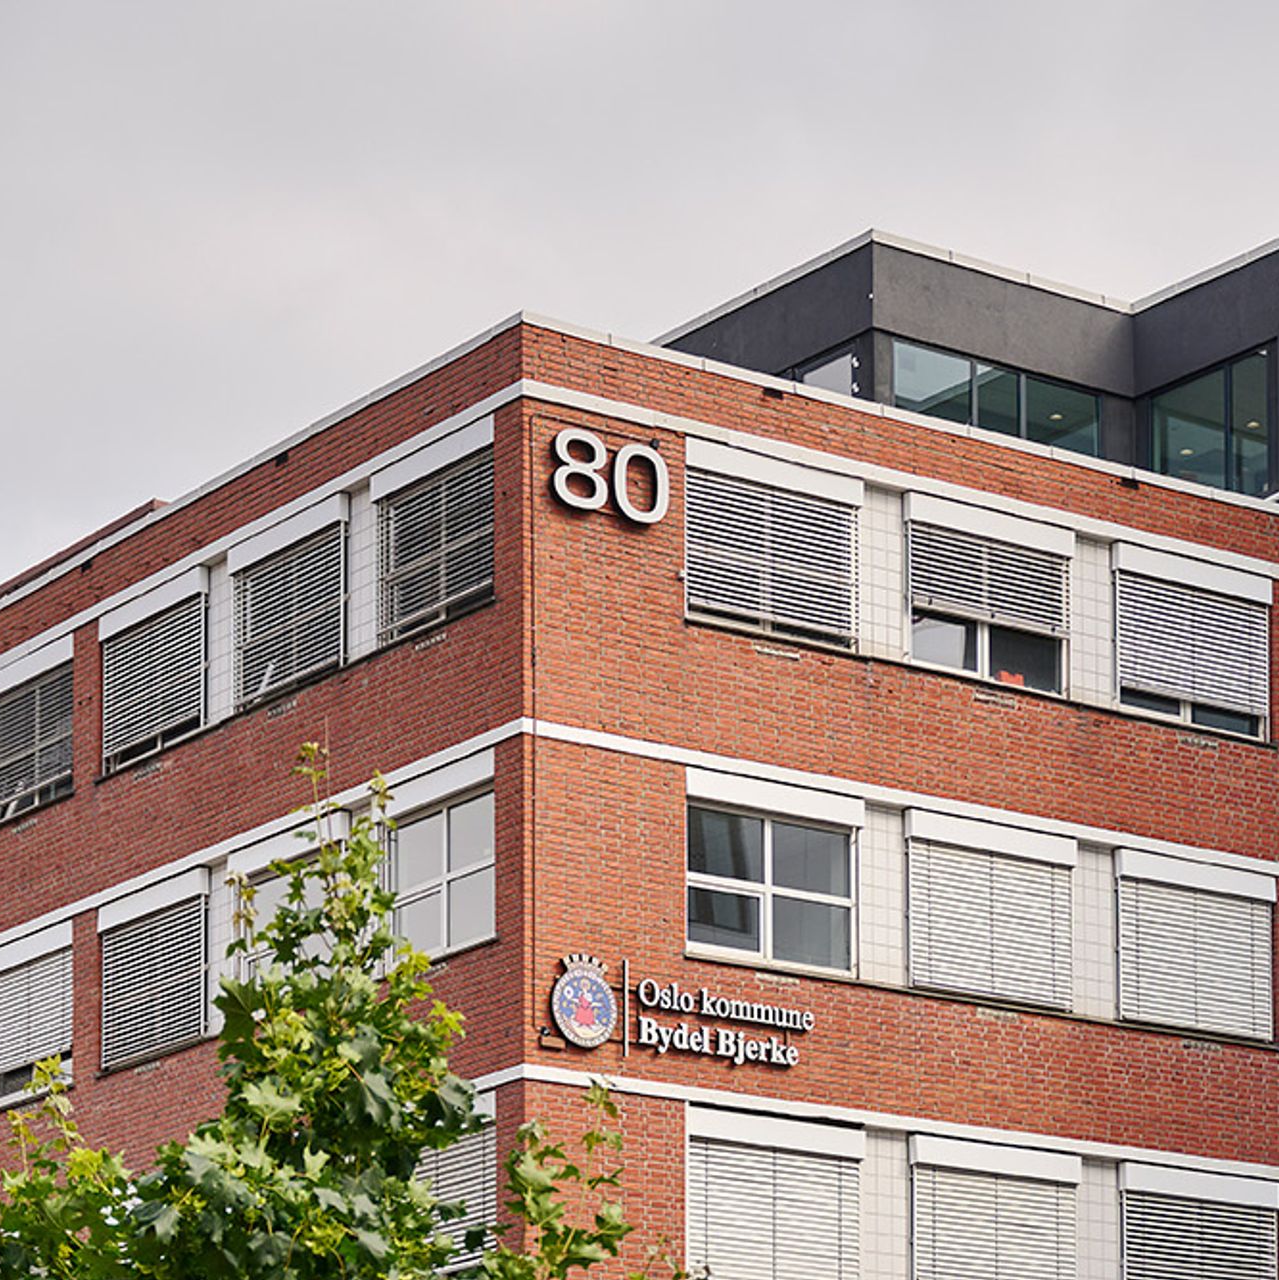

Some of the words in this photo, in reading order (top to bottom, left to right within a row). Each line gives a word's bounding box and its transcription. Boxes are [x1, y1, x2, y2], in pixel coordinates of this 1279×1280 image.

[553, 428, 670, 524] 80
[638, 978, 695, 1014] Oslo
[700, 987, 815, 1031] kommune
[638, 1016, 712, 1054] Bydel
[716, 1028, 800, 1066] Bjerke
